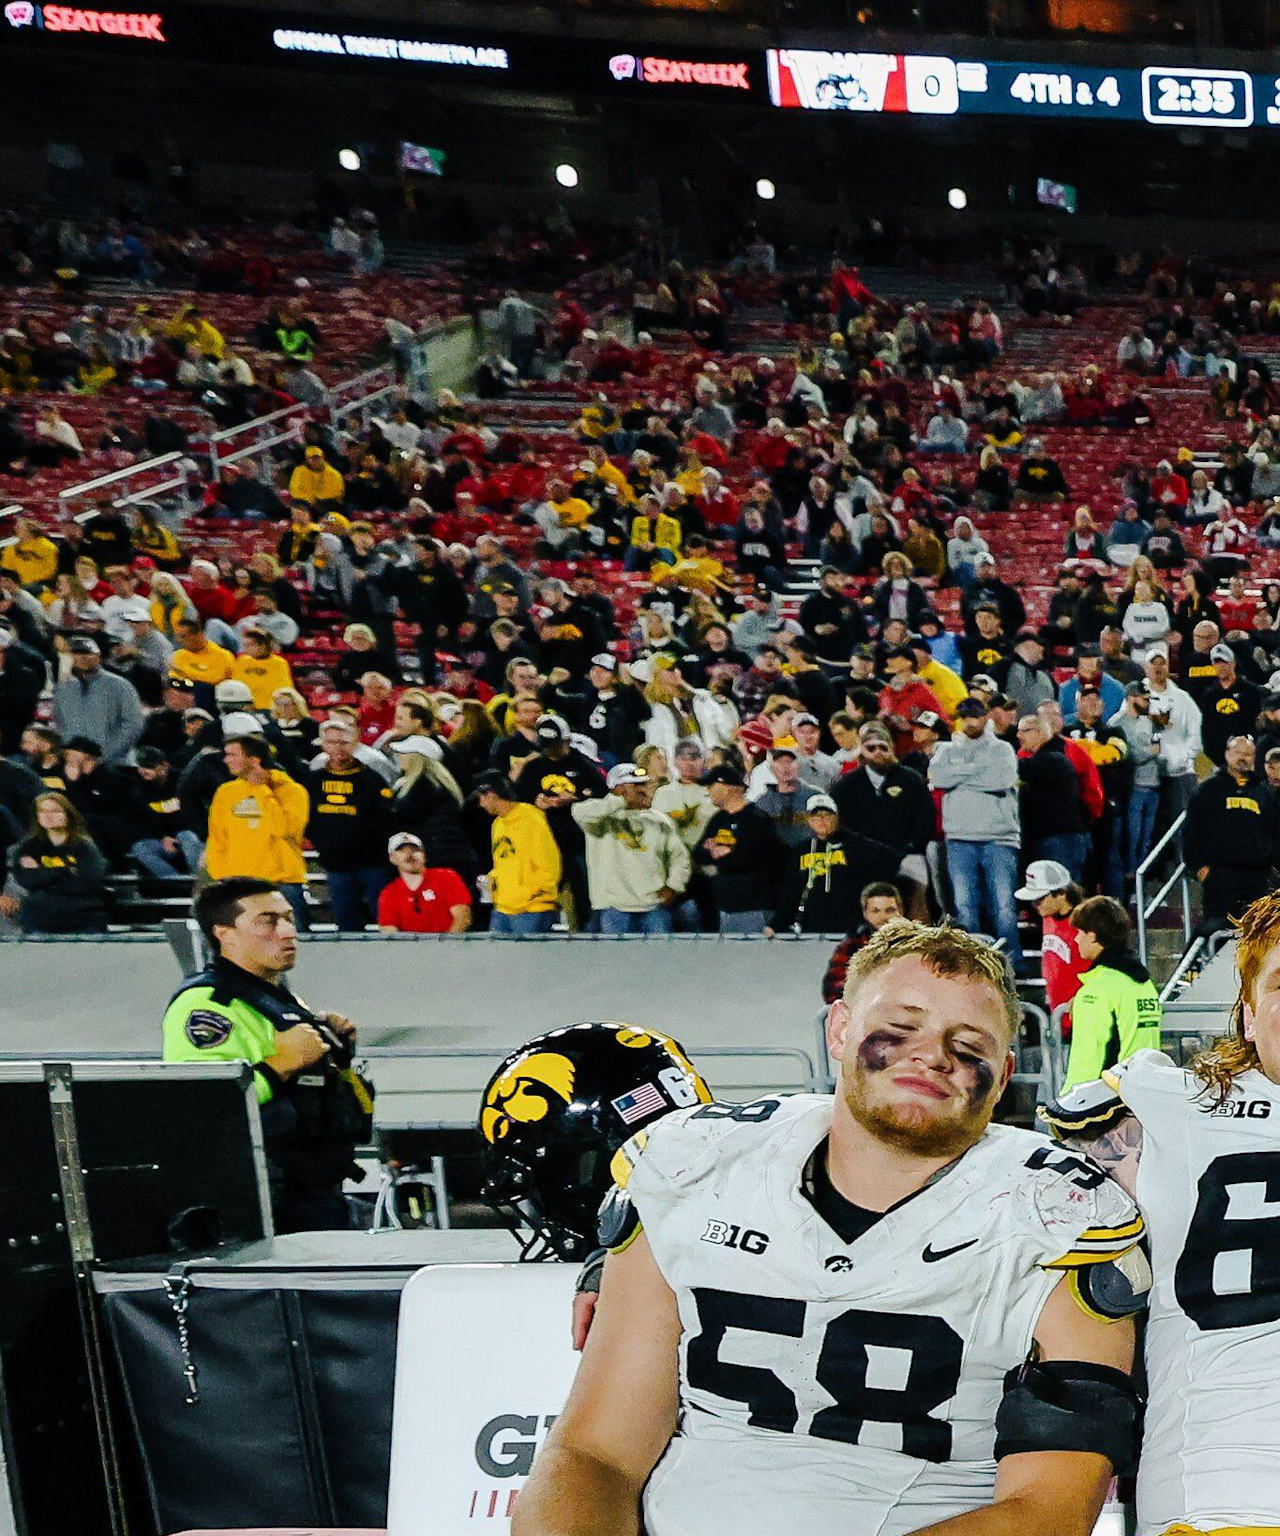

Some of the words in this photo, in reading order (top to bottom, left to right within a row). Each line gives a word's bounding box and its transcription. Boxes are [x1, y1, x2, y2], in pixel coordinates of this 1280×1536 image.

[44, 5, 166, 42] SEATGEEK
[643, 57, 749, 89] SEATGEEK
[924, 75, 940, 97] 0
[1010, 73, 1073, 104] 4TH
[1096, 76, 1120, 107] 4
[1157, 78, 1235, 114] 2:35
[686, 1287, 964, 1463] 58
